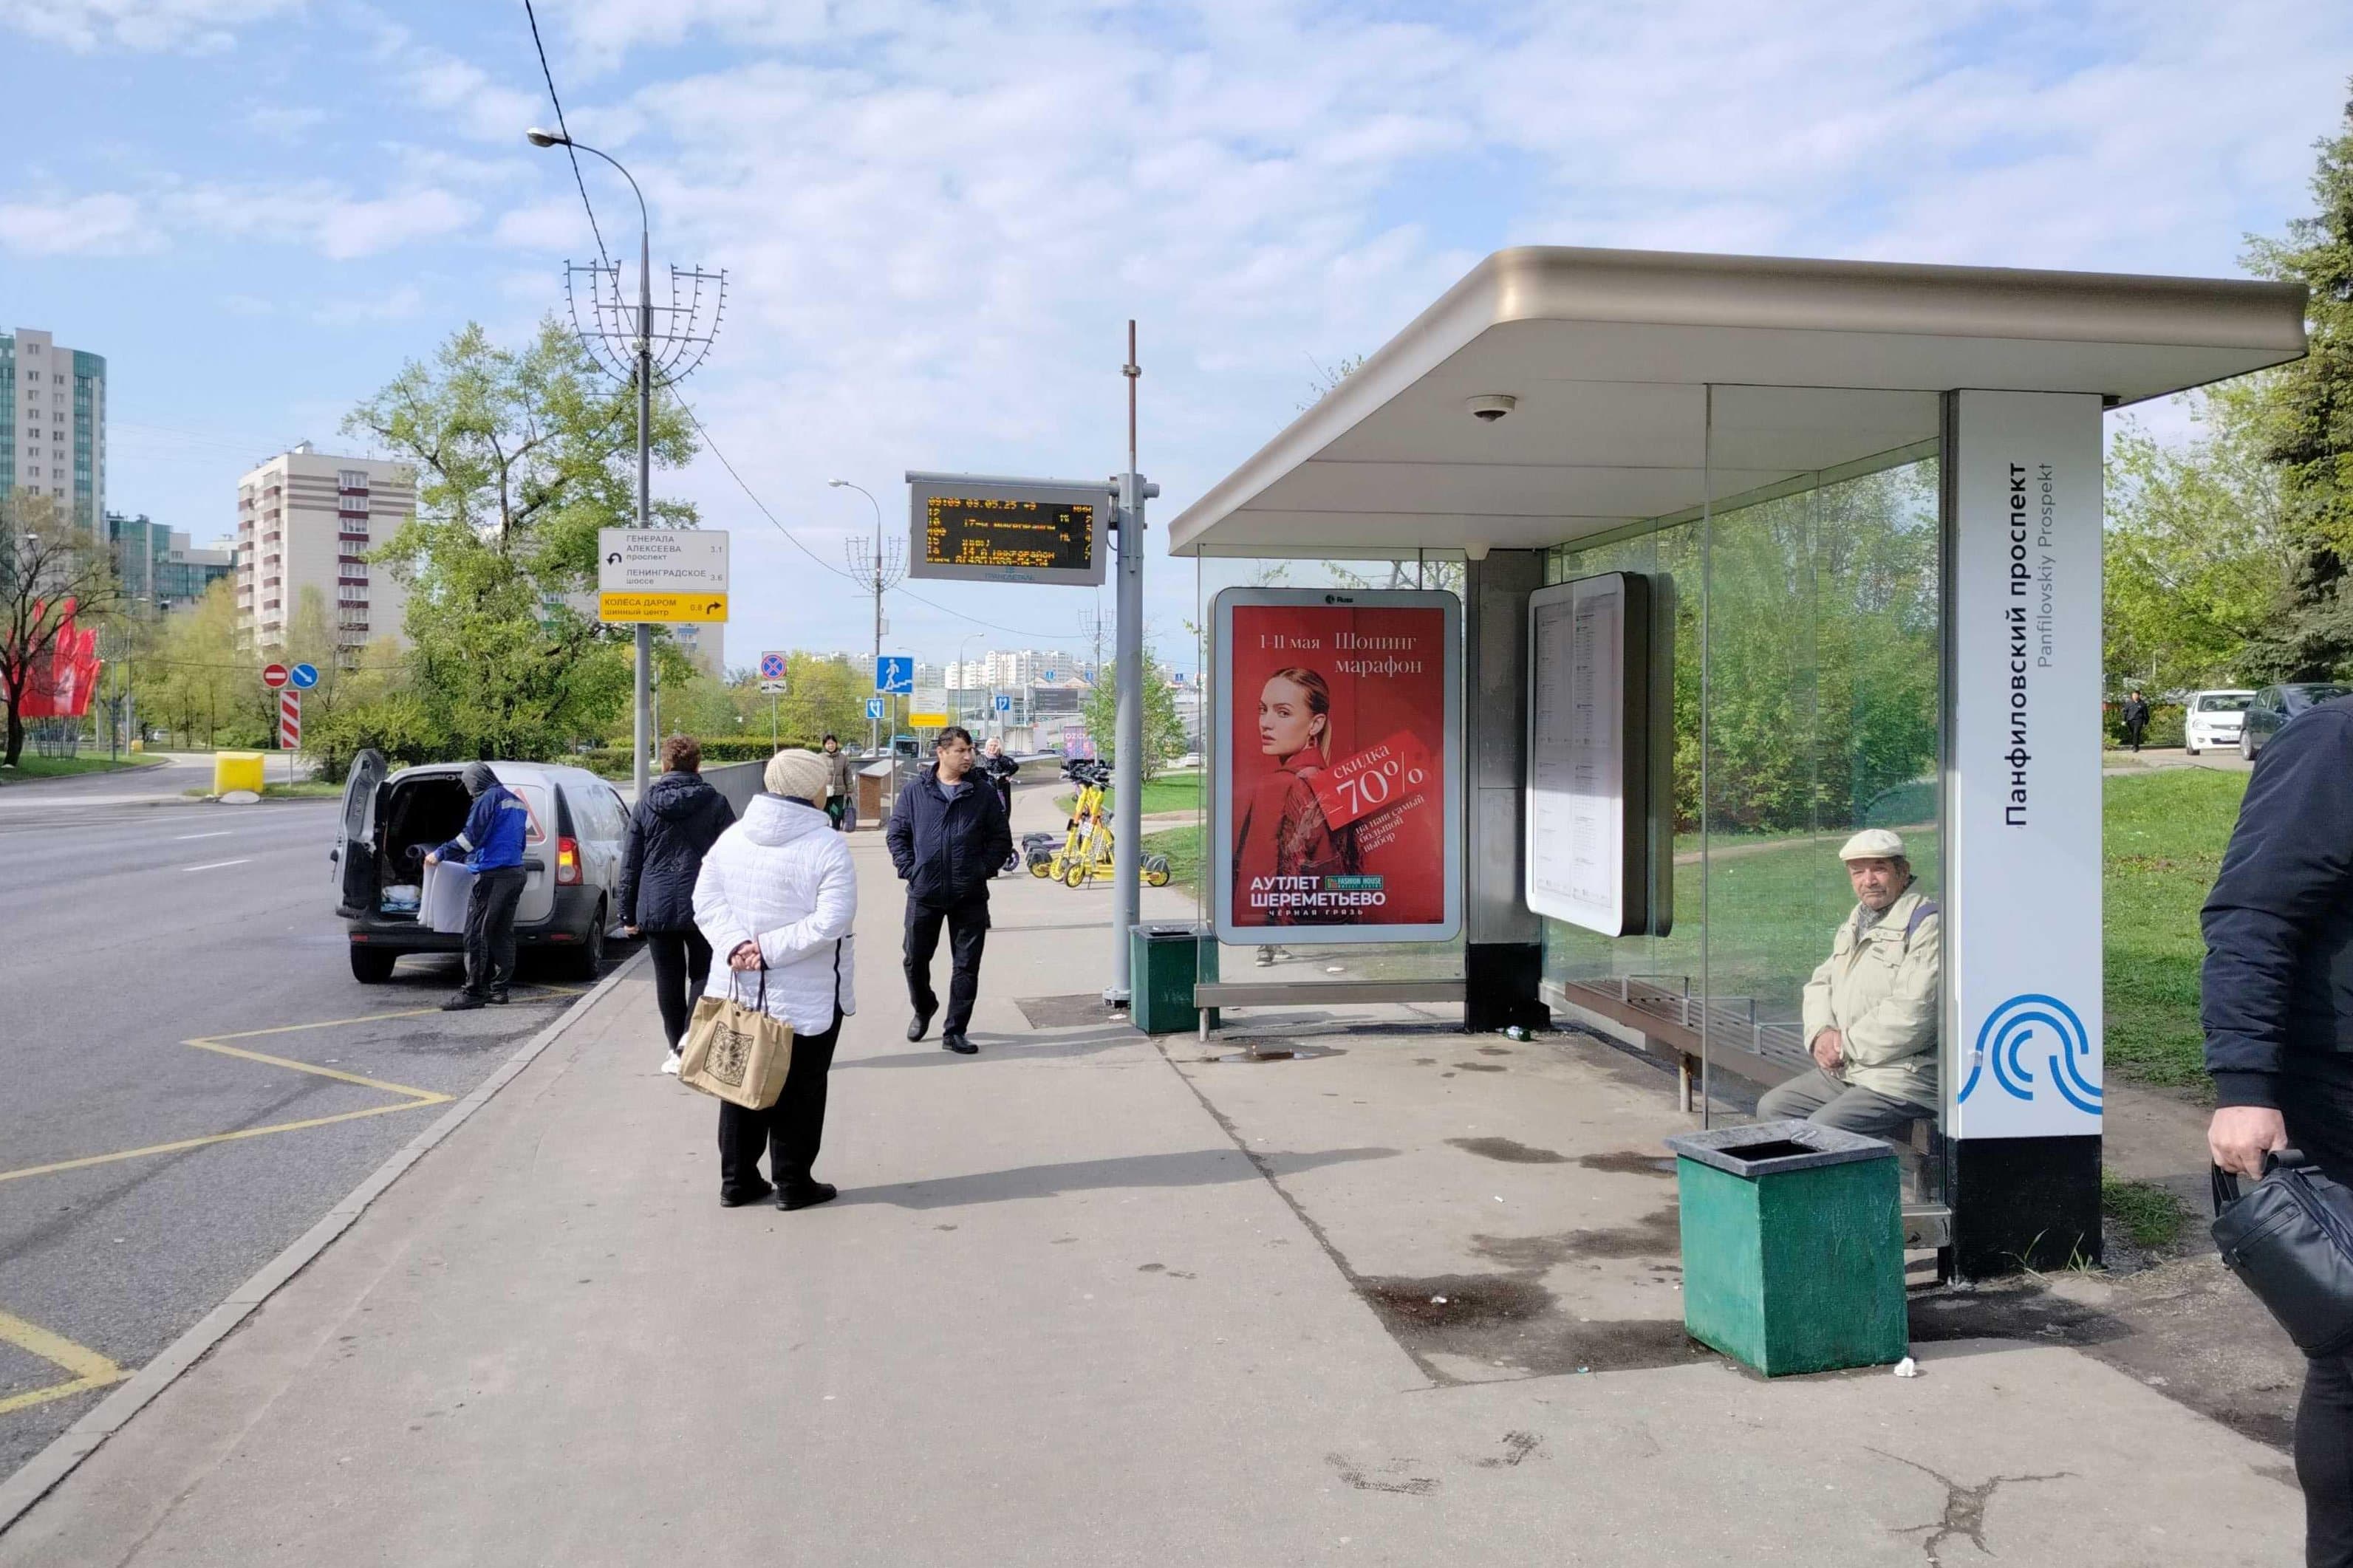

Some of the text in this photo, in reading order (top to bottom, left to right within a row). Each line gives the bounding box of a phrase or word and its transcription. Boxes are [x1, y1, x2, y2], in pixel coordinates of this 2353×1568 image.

[626, 535, 675, 543] ГЕНЕРАЛА
[626, 569, 706, 578] ЛЕНИНГРАДСКОЕ
[2037, 462, 2056, 668] Panfilovskiy Prospekt
[1260, 634, 1320, 649] 1-11 мая
[1335, 632, 1416, 650] Шопинг
[2004, 462, 2032, 826] Панфиловский проспект
[1335, 656, 1421, 677] марафон
[1333, 745, 1390, 779] скидка
[1355, 794, 1425, 835] на наш самый
[1359, 815, 1404, 843] большой
[1363, 832, 1396, 853] выбор
[1251, 876, 1320, 890] АУТЛЕТ
[1338, 877, 1382, 885] FASHION HOUSE
[1251, 891, 1386, 907] ШЕРЕМЕТЬЕВО
